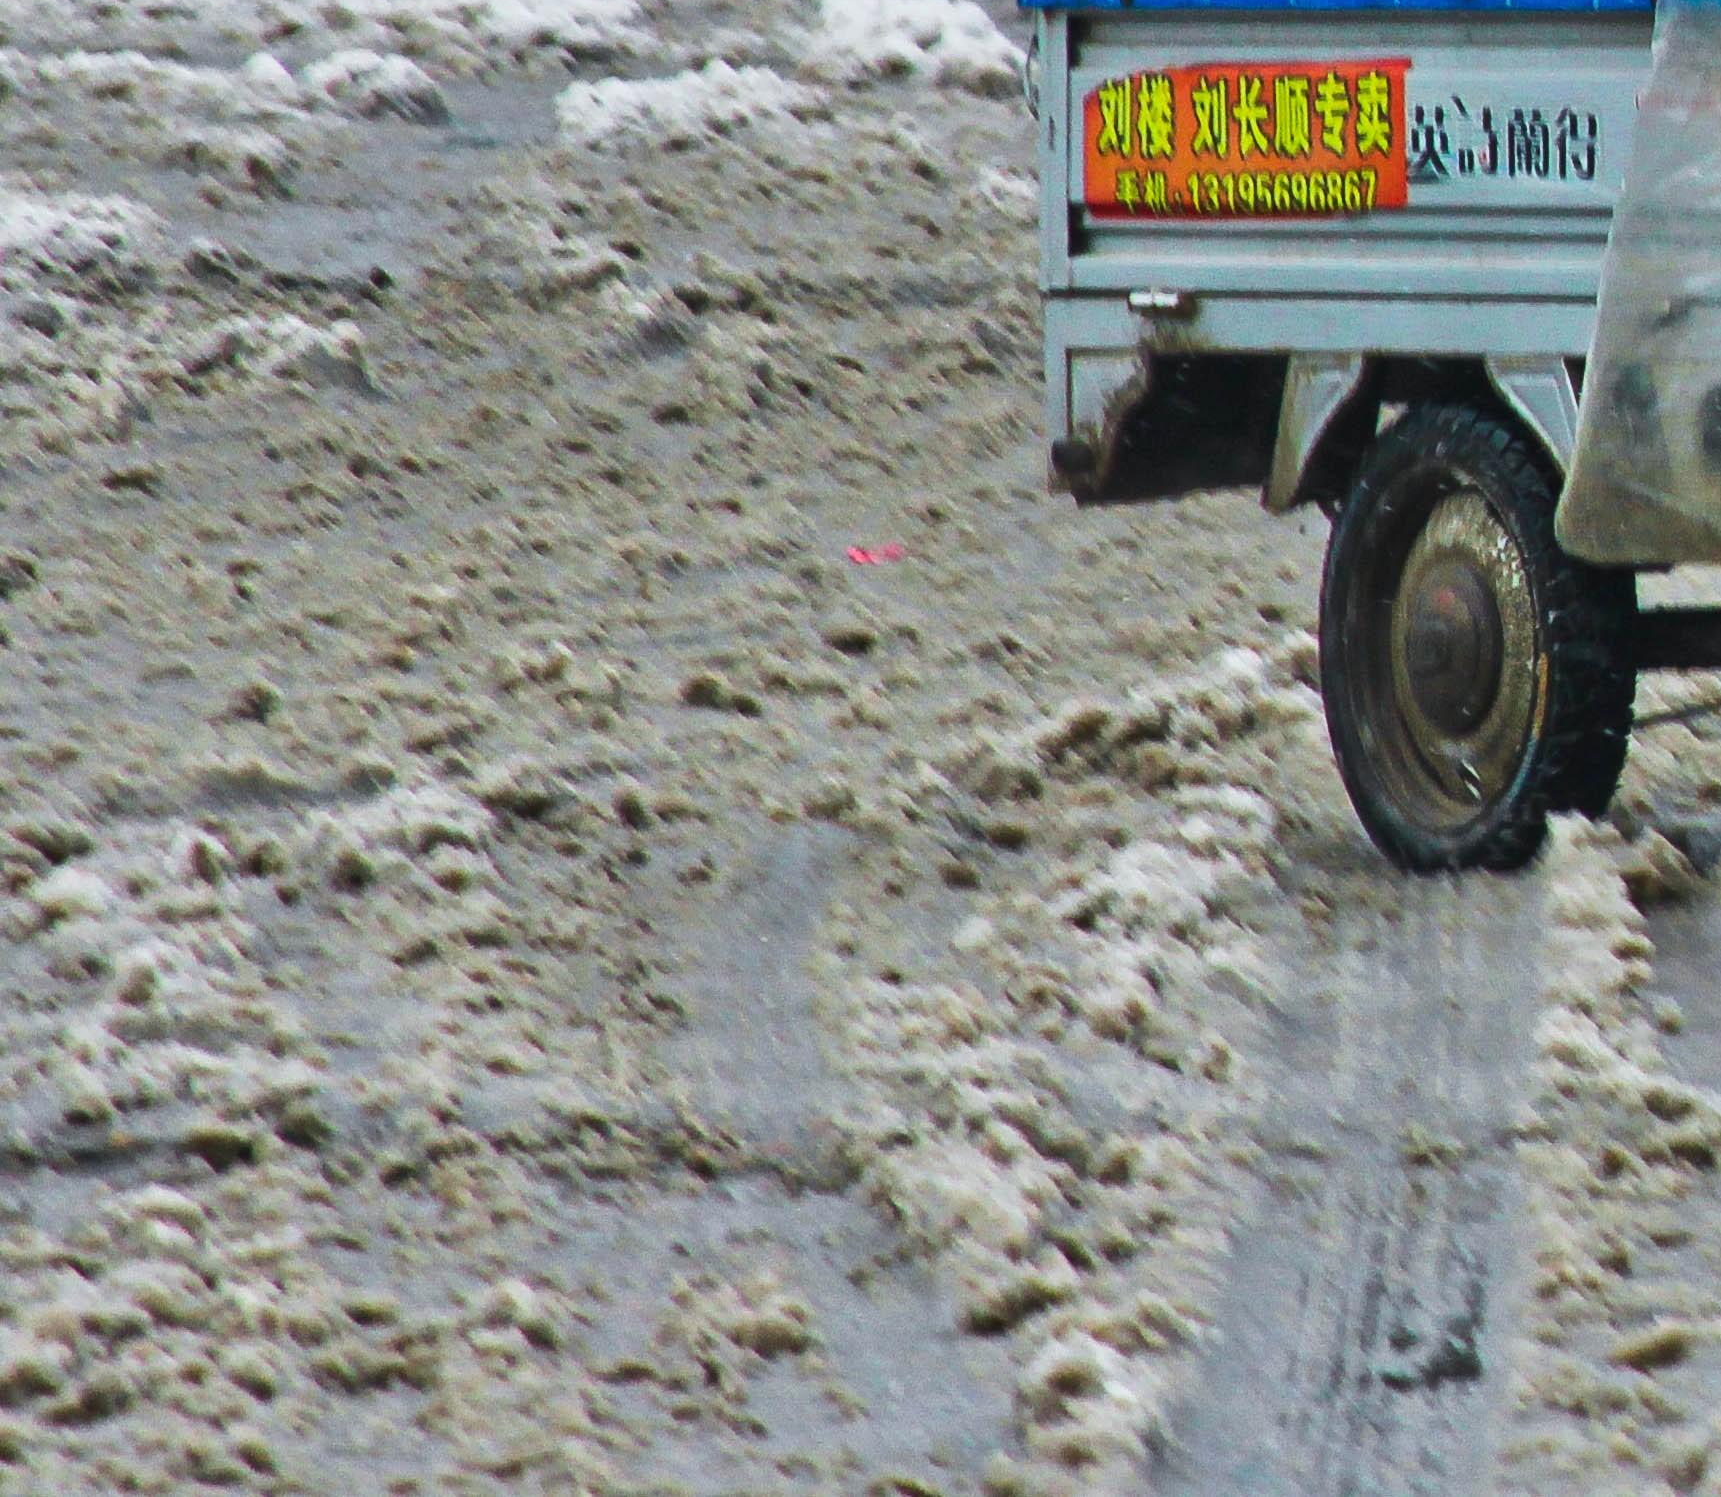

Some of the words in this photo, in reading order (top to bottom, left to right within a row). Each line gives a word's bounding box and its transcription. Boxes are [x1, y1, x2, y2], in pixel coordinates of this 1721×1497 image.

[1098, 72, 1174, 160] 刘楼
[1191, 70, 1391, 160] 刘长顺专卖
